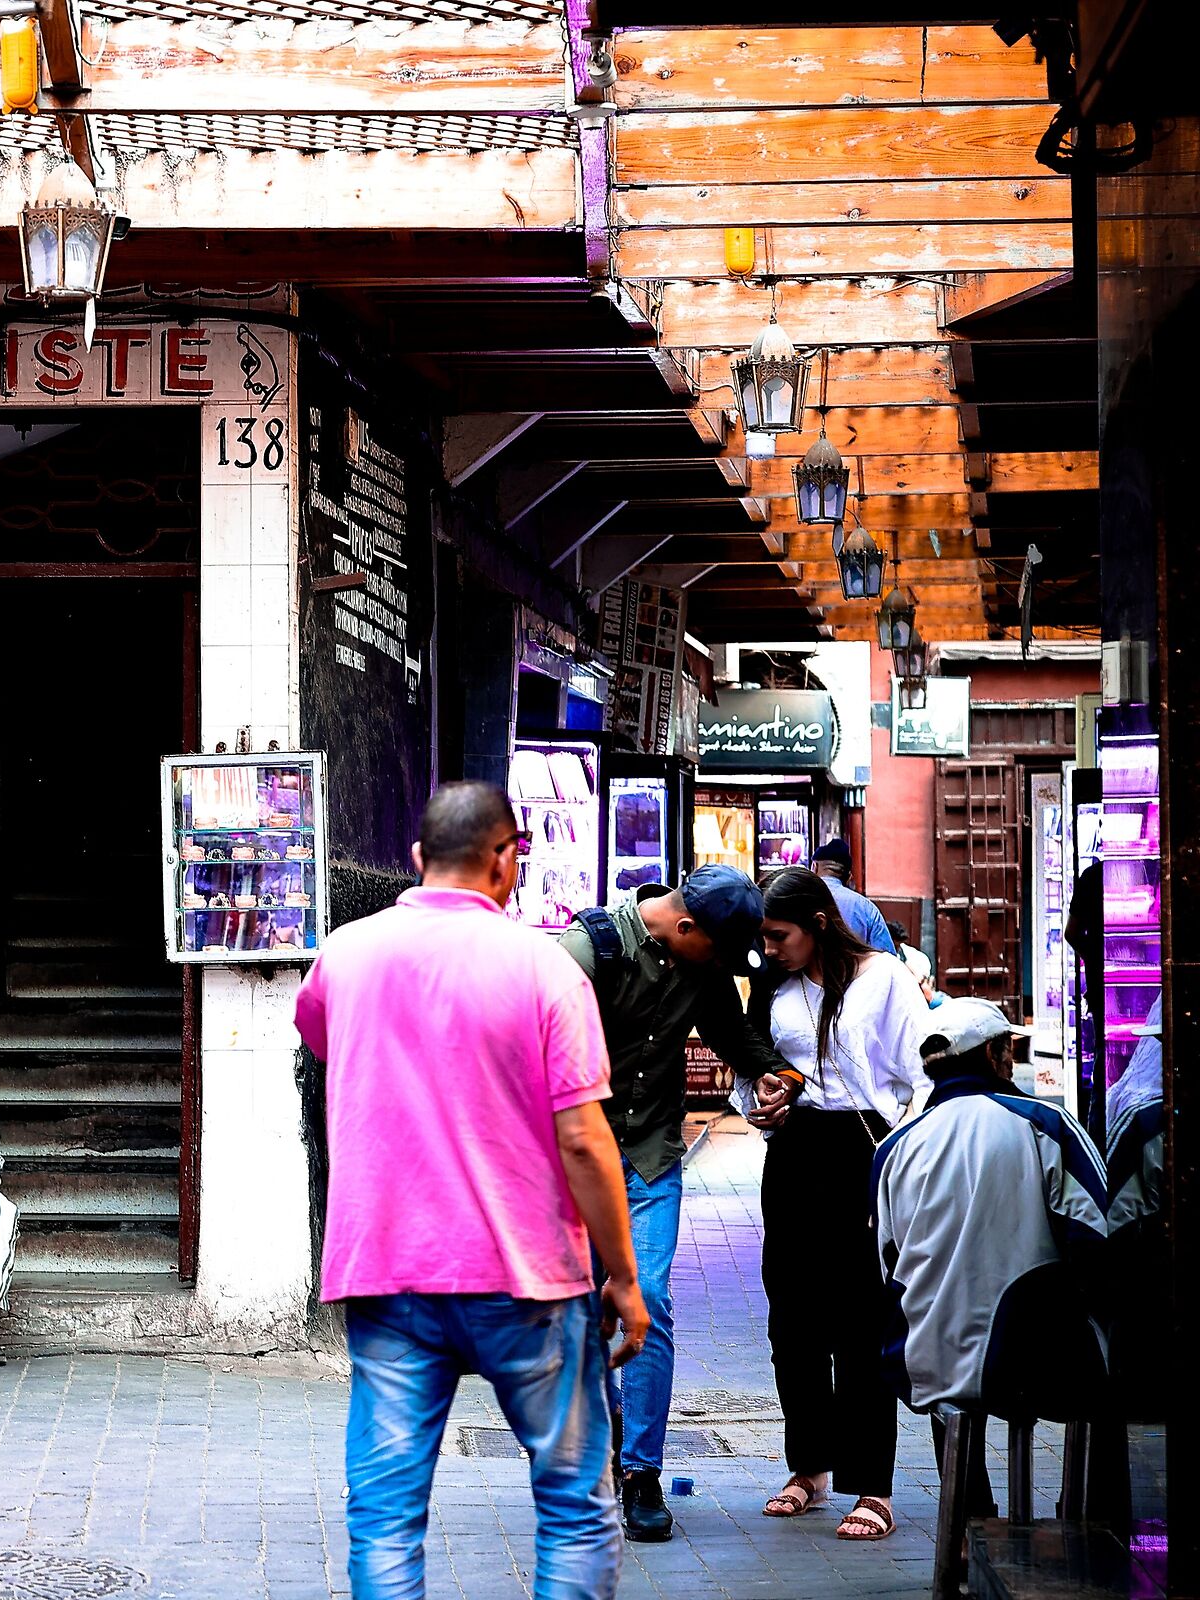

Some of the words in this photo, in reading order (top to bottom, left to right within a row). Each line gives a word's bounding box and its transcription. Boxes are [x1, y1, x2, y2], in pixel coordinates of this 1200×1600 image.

[215, 416, 285, 471] 138
[627, 581, 639, 637] PIERCING
[625, 636, 636, 660] BODY
